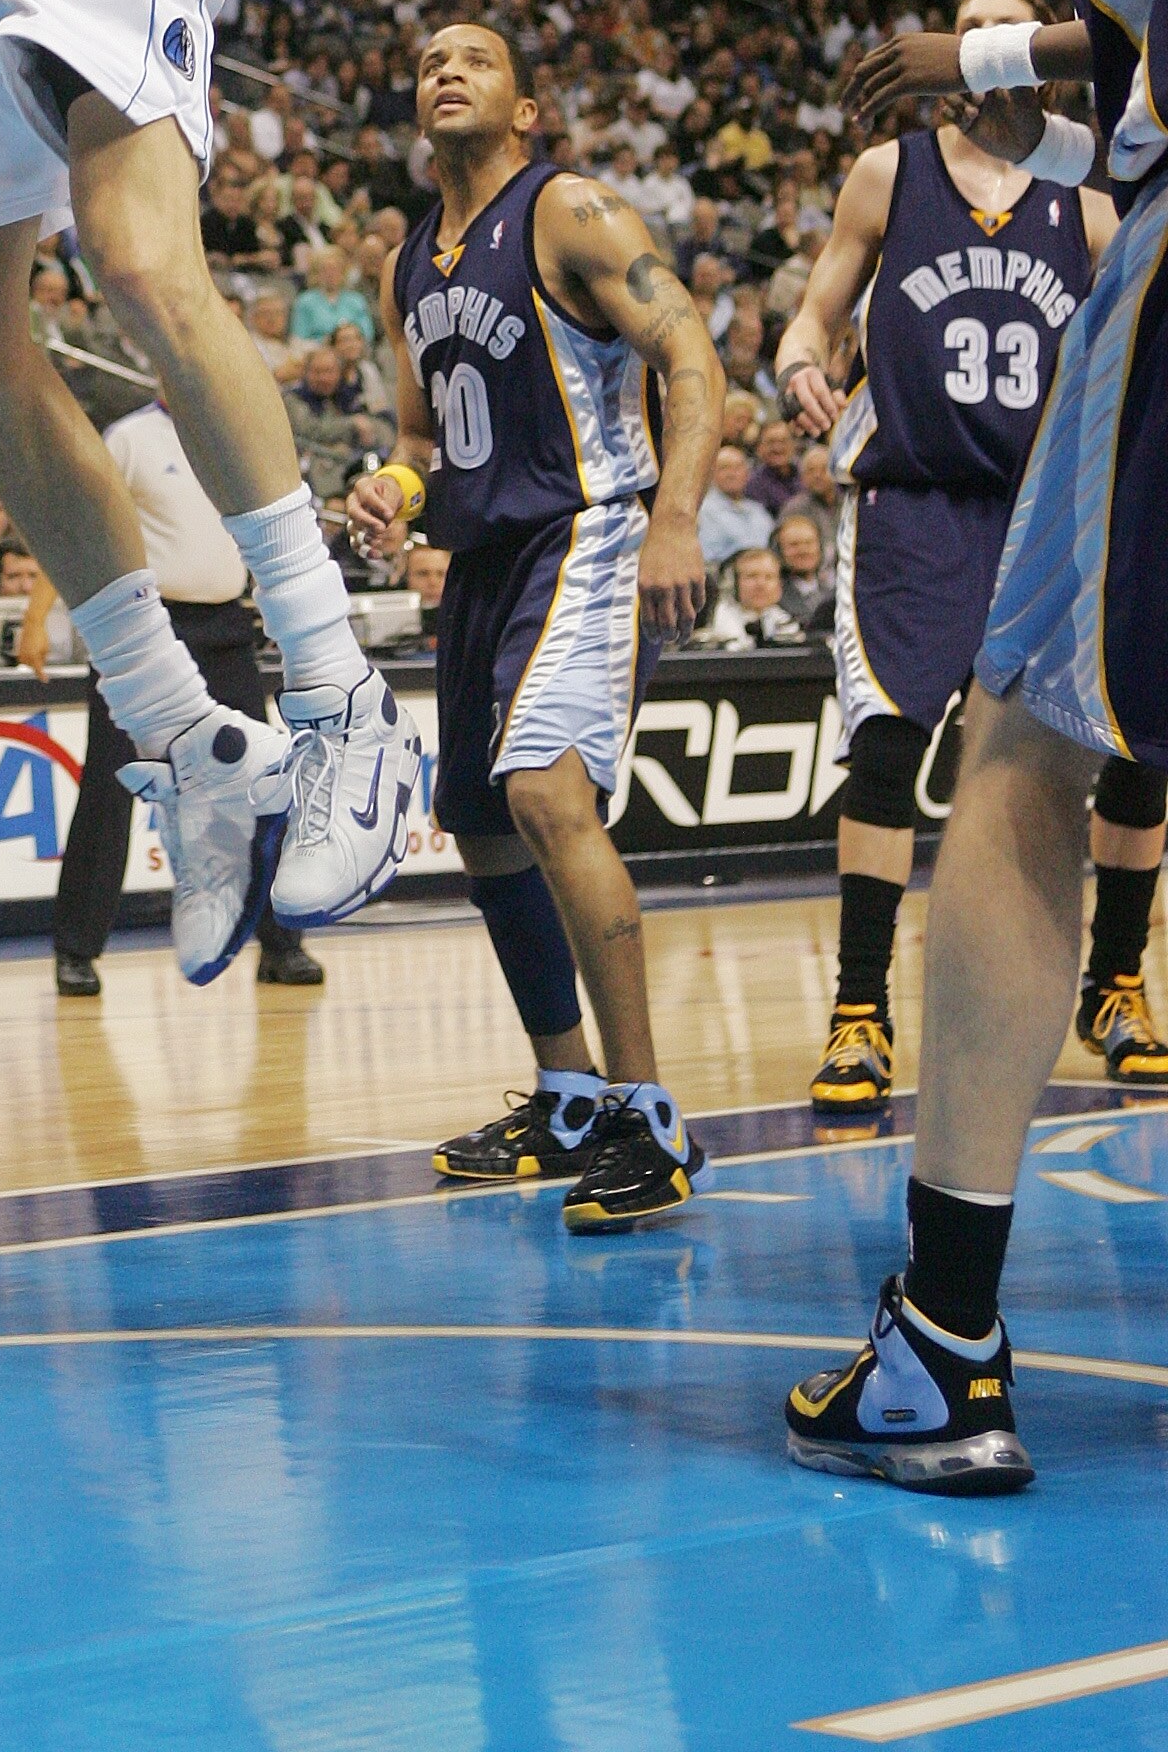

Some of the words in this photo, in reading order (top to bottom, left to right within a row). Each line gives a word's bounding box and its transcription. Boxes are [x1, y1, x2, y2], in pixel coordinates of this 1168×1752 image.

[899, 246, 1078, 329] MEMPHIS
[943, 316, 1040, 410] 33
[967, 1377, 1003, 1400] NIKE
